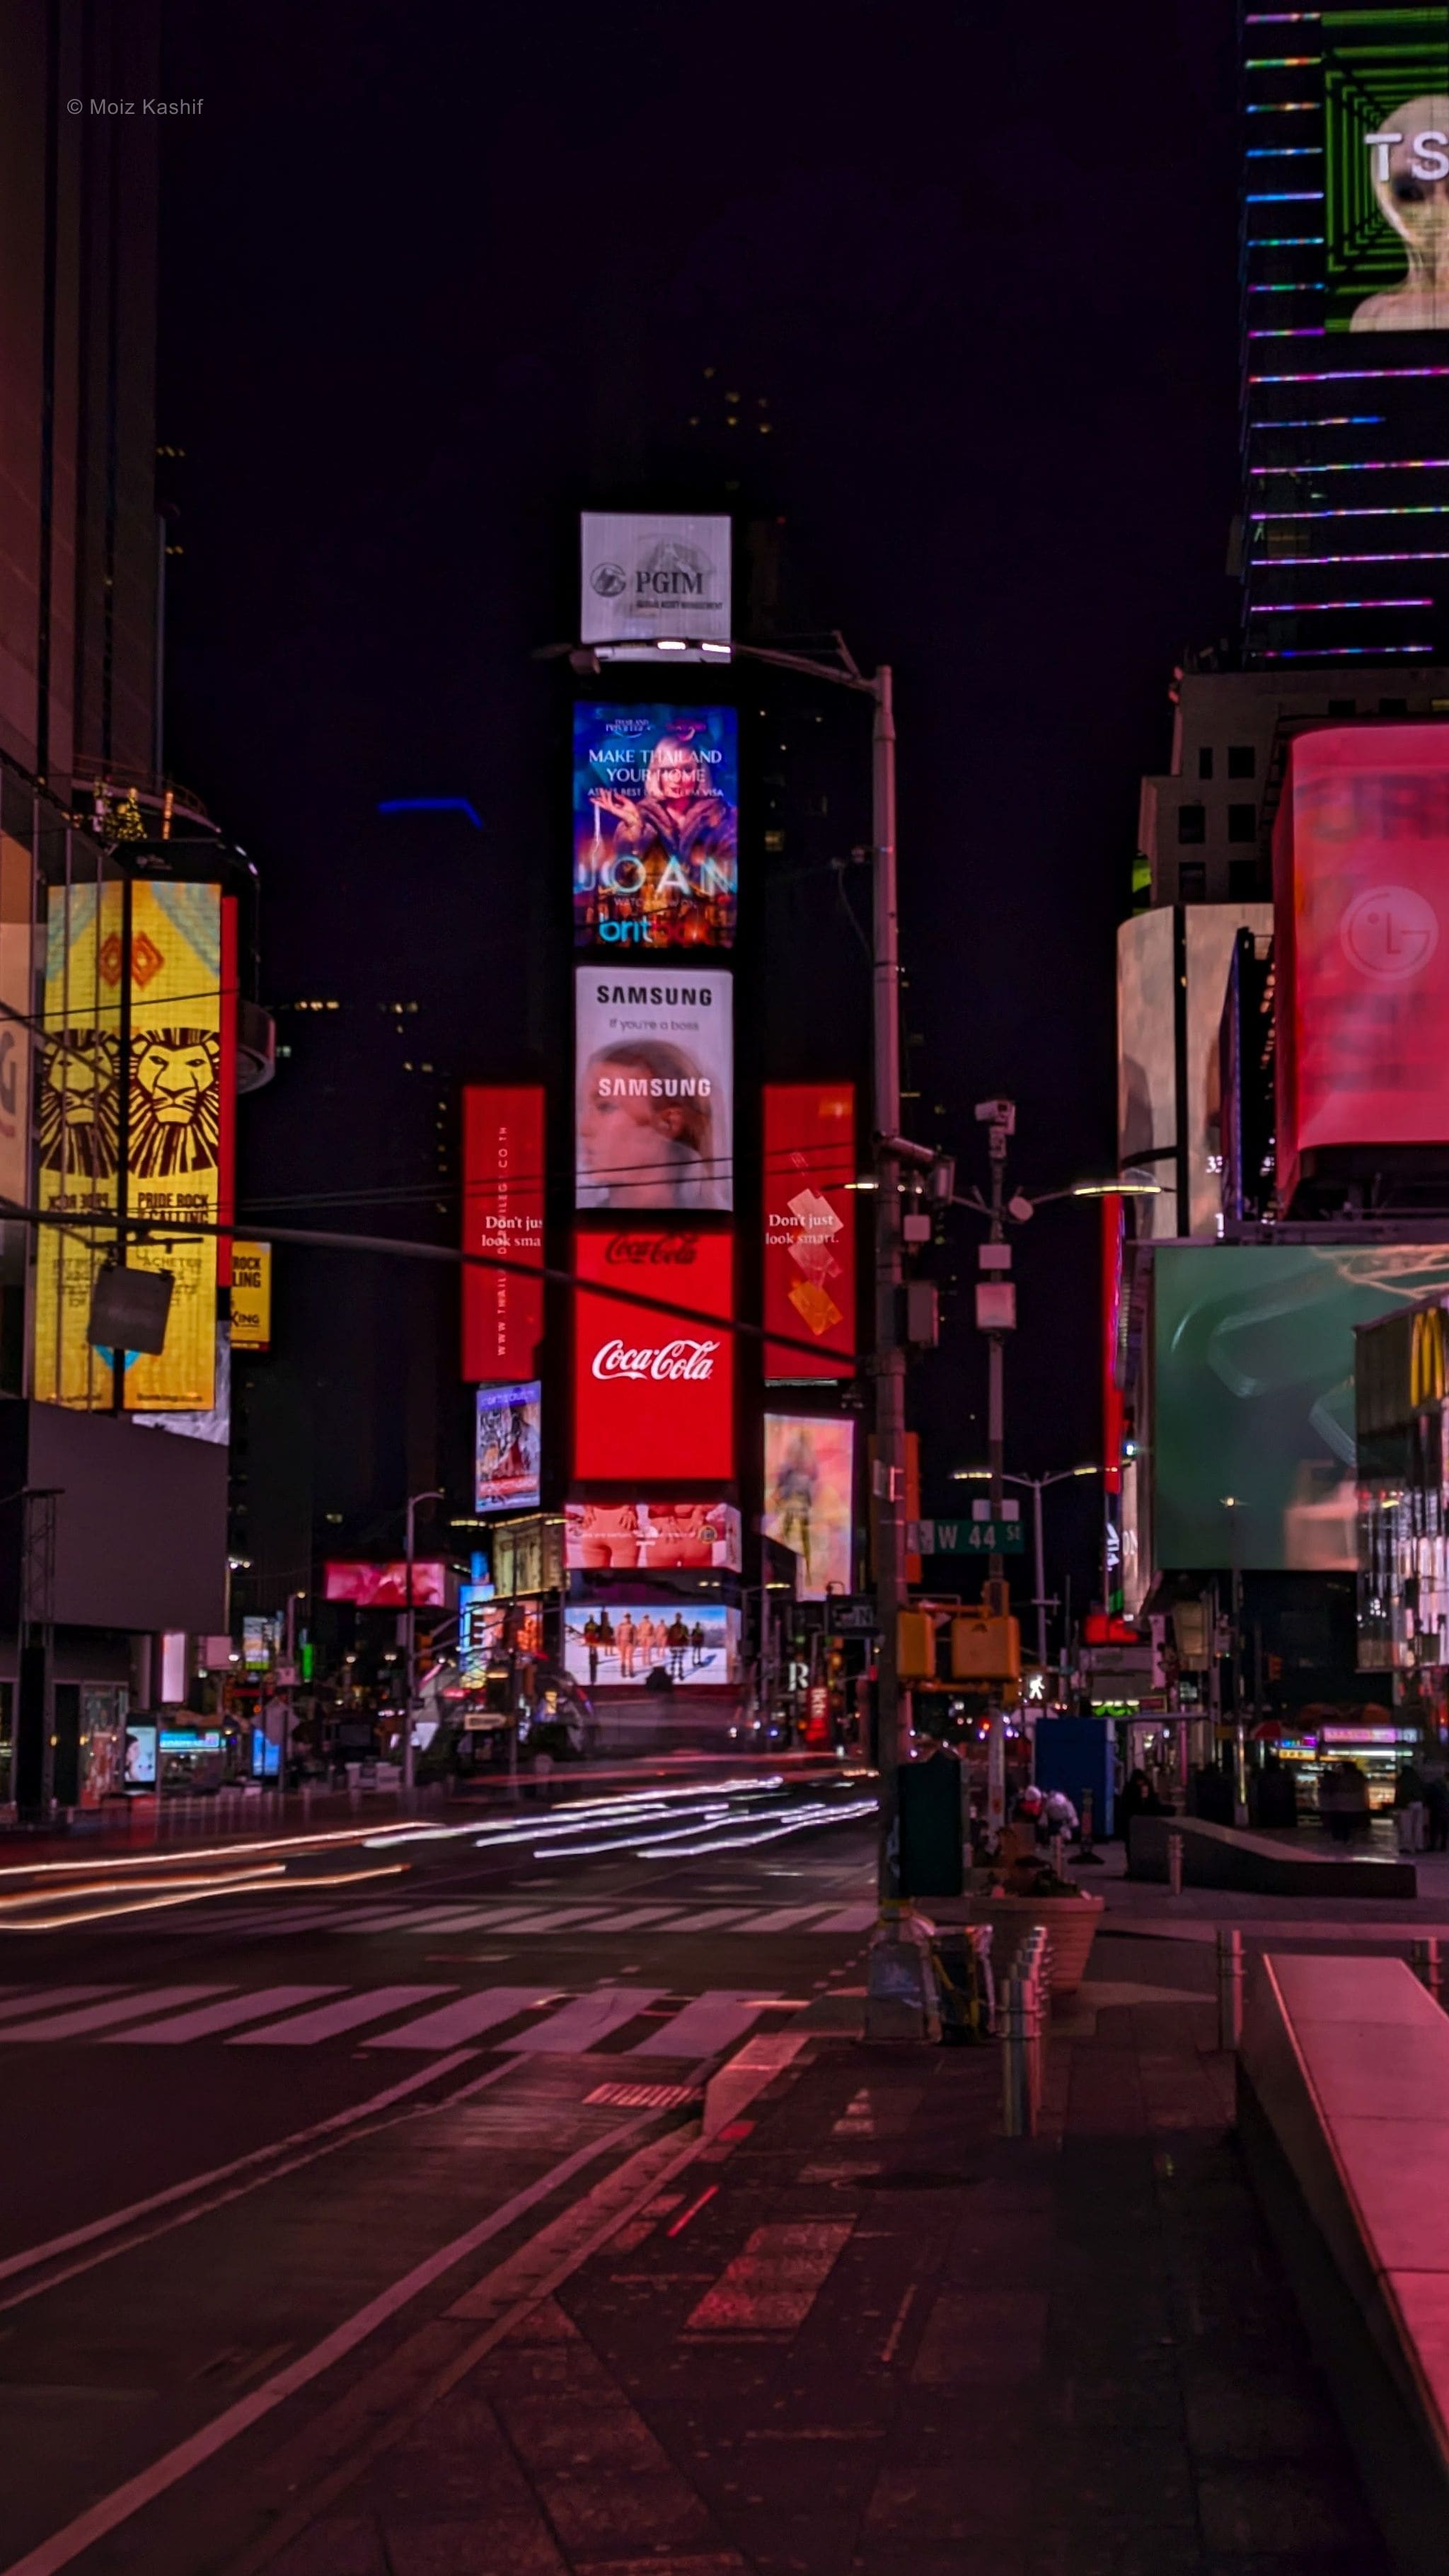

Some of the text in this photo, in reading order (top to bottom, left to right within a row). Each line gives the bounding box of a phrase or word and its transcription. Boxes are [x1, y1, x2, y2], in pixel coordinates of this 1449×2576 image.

[635, 570, 703, 594] PGIM
[589, 749, 722, 764] MAKE THAILAND
[606, 768, 706, 783] YOUR HOME
[573, 853, 738, 898] JOAN
[596, 985, 712, 1007] SAMSUNG
[620, 1019, 657, 1032] you're
[659, 1022, 669, 1031] a
[671, 1019, 700, 1032] boss
[598, 1078, 712, 1097] SAMSUNG
[137, 1192, 209, 1208] PRIDE ROCK
[485, 1215, 524, 1229] Don't
[768, 1213, 834, 1230] Don't just
[481, 1234, 511, 1247] look
[766, 1232, 794, 1245] look
[937, 1525, 959, 1549] W
[968, 1524, 997, 1550] 44
[787, 1661, 809, 1692] R
